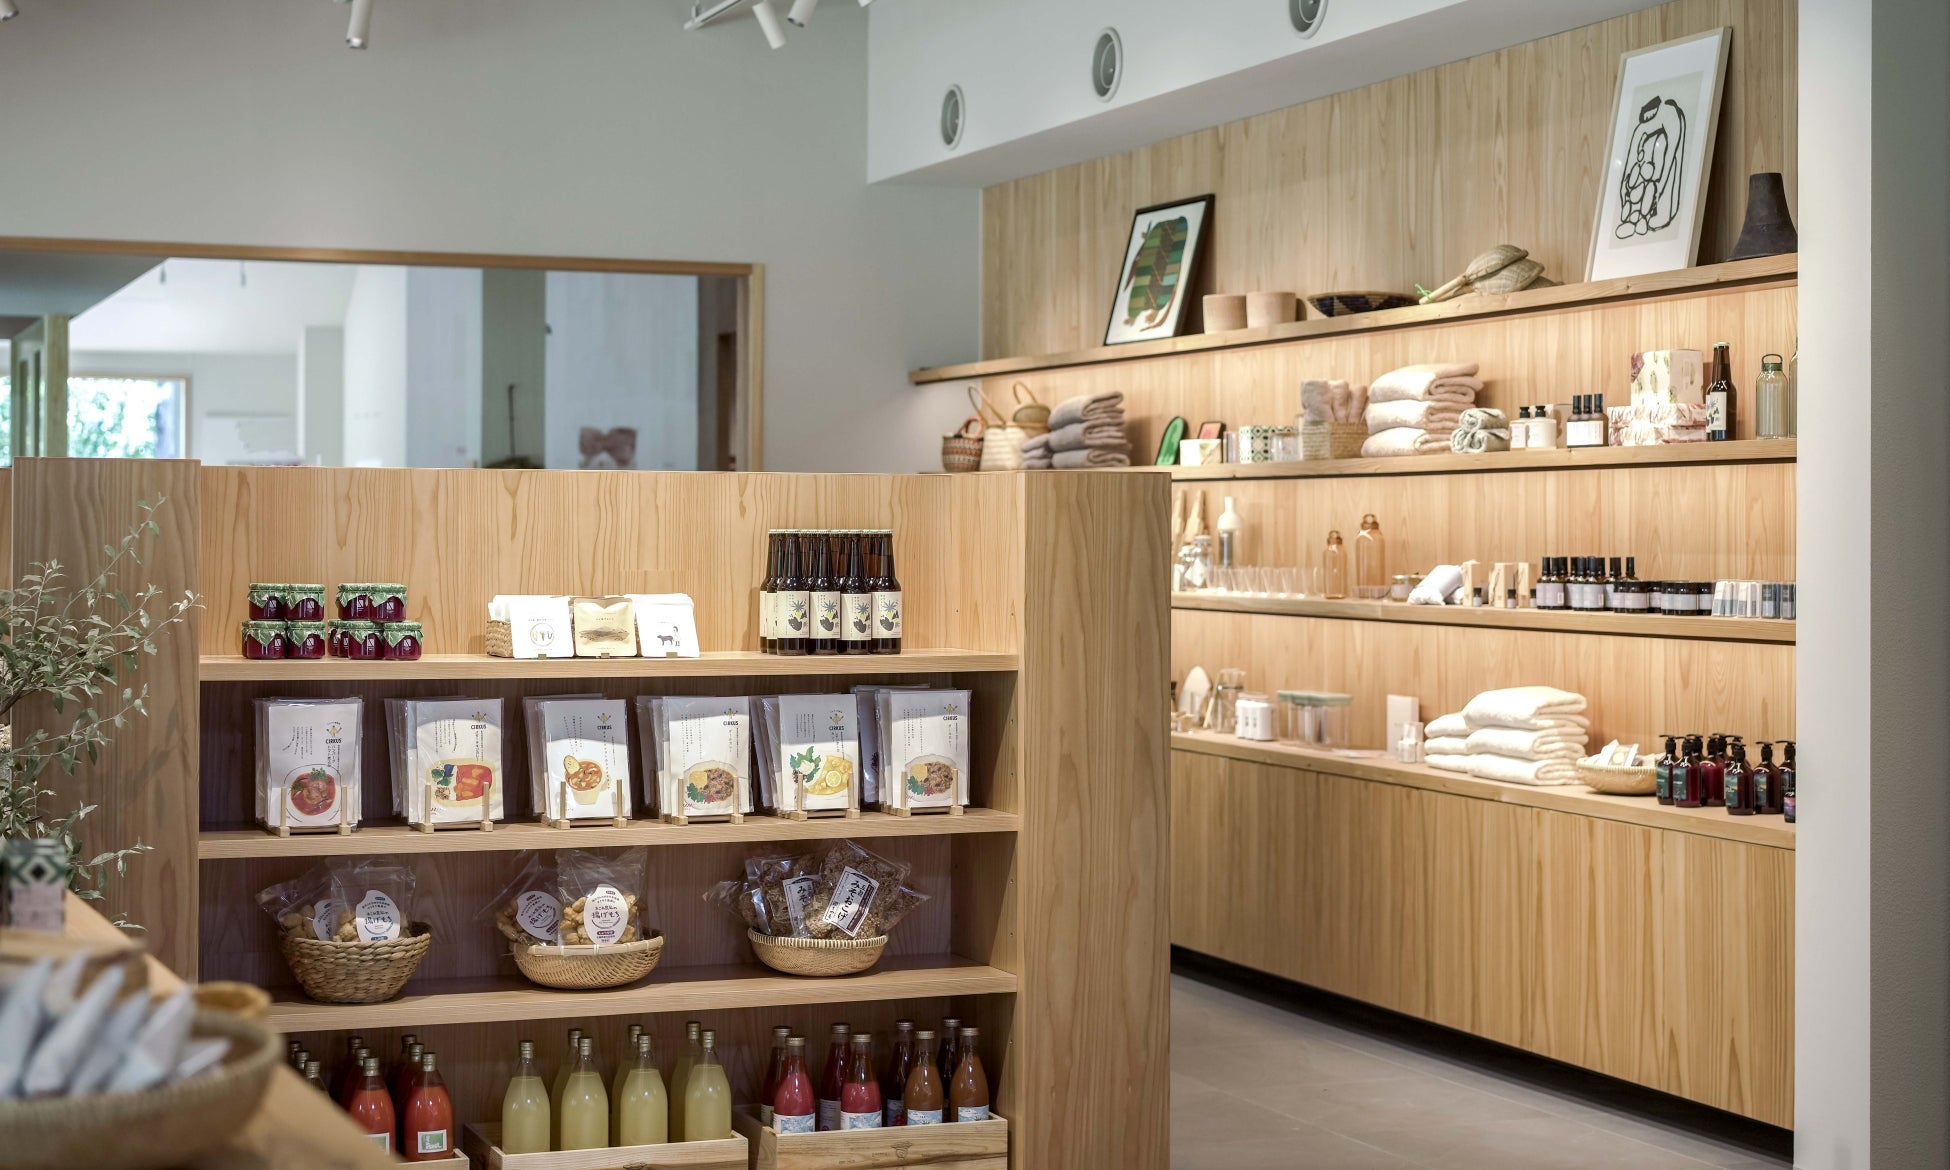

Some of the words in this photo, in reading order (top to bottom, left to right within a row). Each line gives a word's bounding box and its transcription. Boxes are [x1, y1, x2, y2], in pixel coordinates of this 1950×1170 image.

[837, 881, 860, 921] みそおこげ
